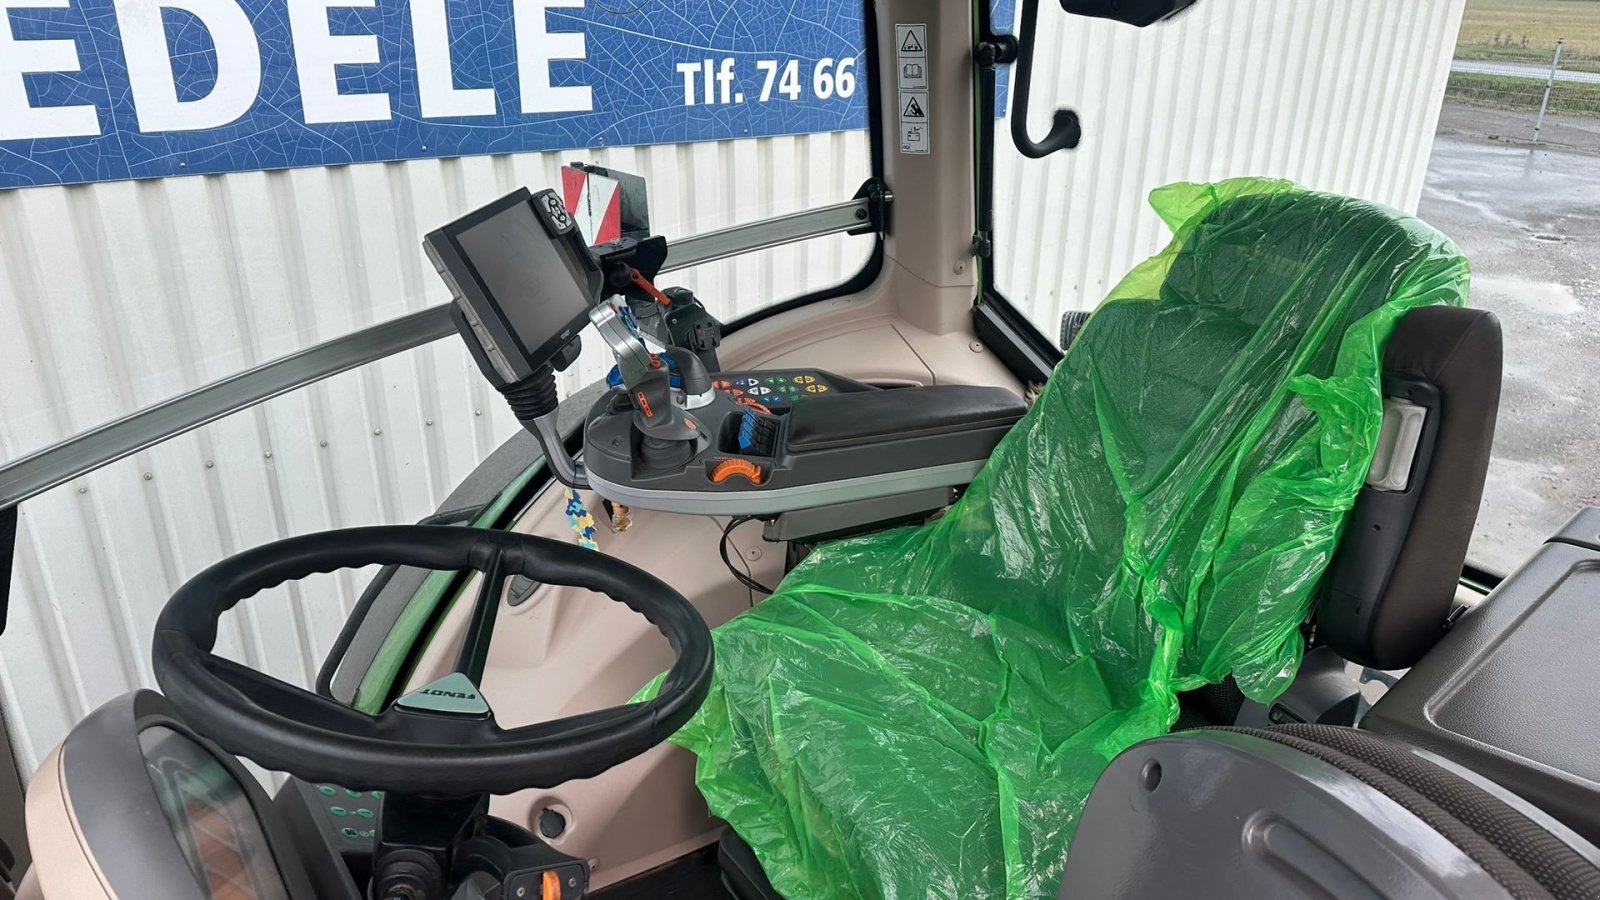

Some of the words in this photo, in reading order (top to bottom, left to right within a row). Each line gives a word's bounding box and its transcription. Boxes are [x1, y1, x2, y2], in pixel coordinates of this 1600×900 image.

[676, 57, 744, 106] Tlf.
[756, 59, 802, 102] 74
[813, 57, 856, 100] 66
[419, 689, 476, 700] FENDT
